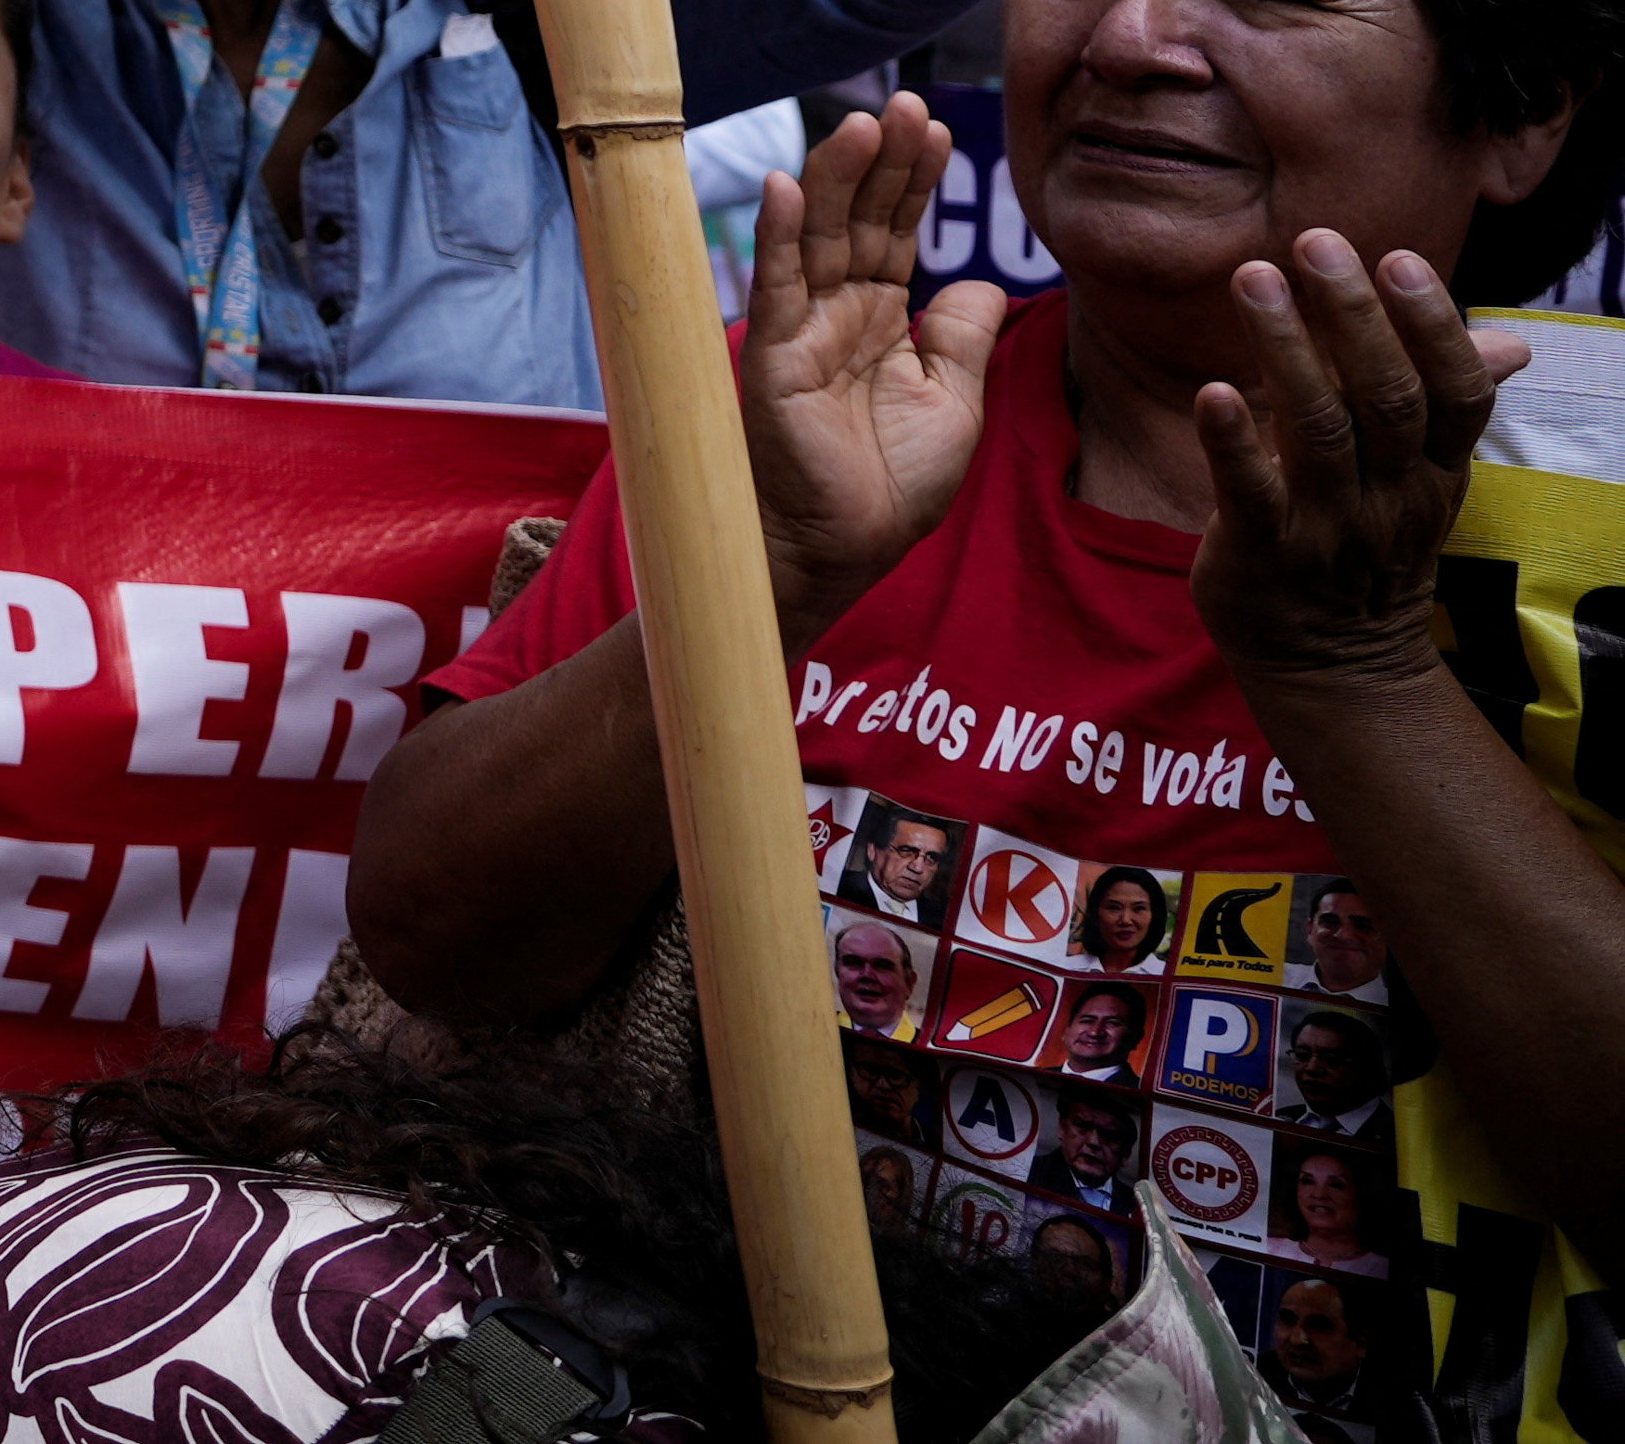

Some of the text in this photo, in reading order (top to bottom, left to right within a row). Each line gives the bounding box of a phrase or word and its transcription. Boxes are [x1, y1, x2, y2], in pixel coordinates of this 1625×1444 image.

[1065, 721, 1125, 795] se
[1142, 738, 1247, 809] vota
[977, 852, 1061, 940] K
[1205, 959, 1235, 971] para
[1236, 960, 1274, 973] Todos
[1183, 998, 1249, 1073] P
[957, 1074, 1016, 1143] A
[1170, 1070, 1260, 1102] PODEMOS
[1171, 1156, 1239, 1191] CPP
